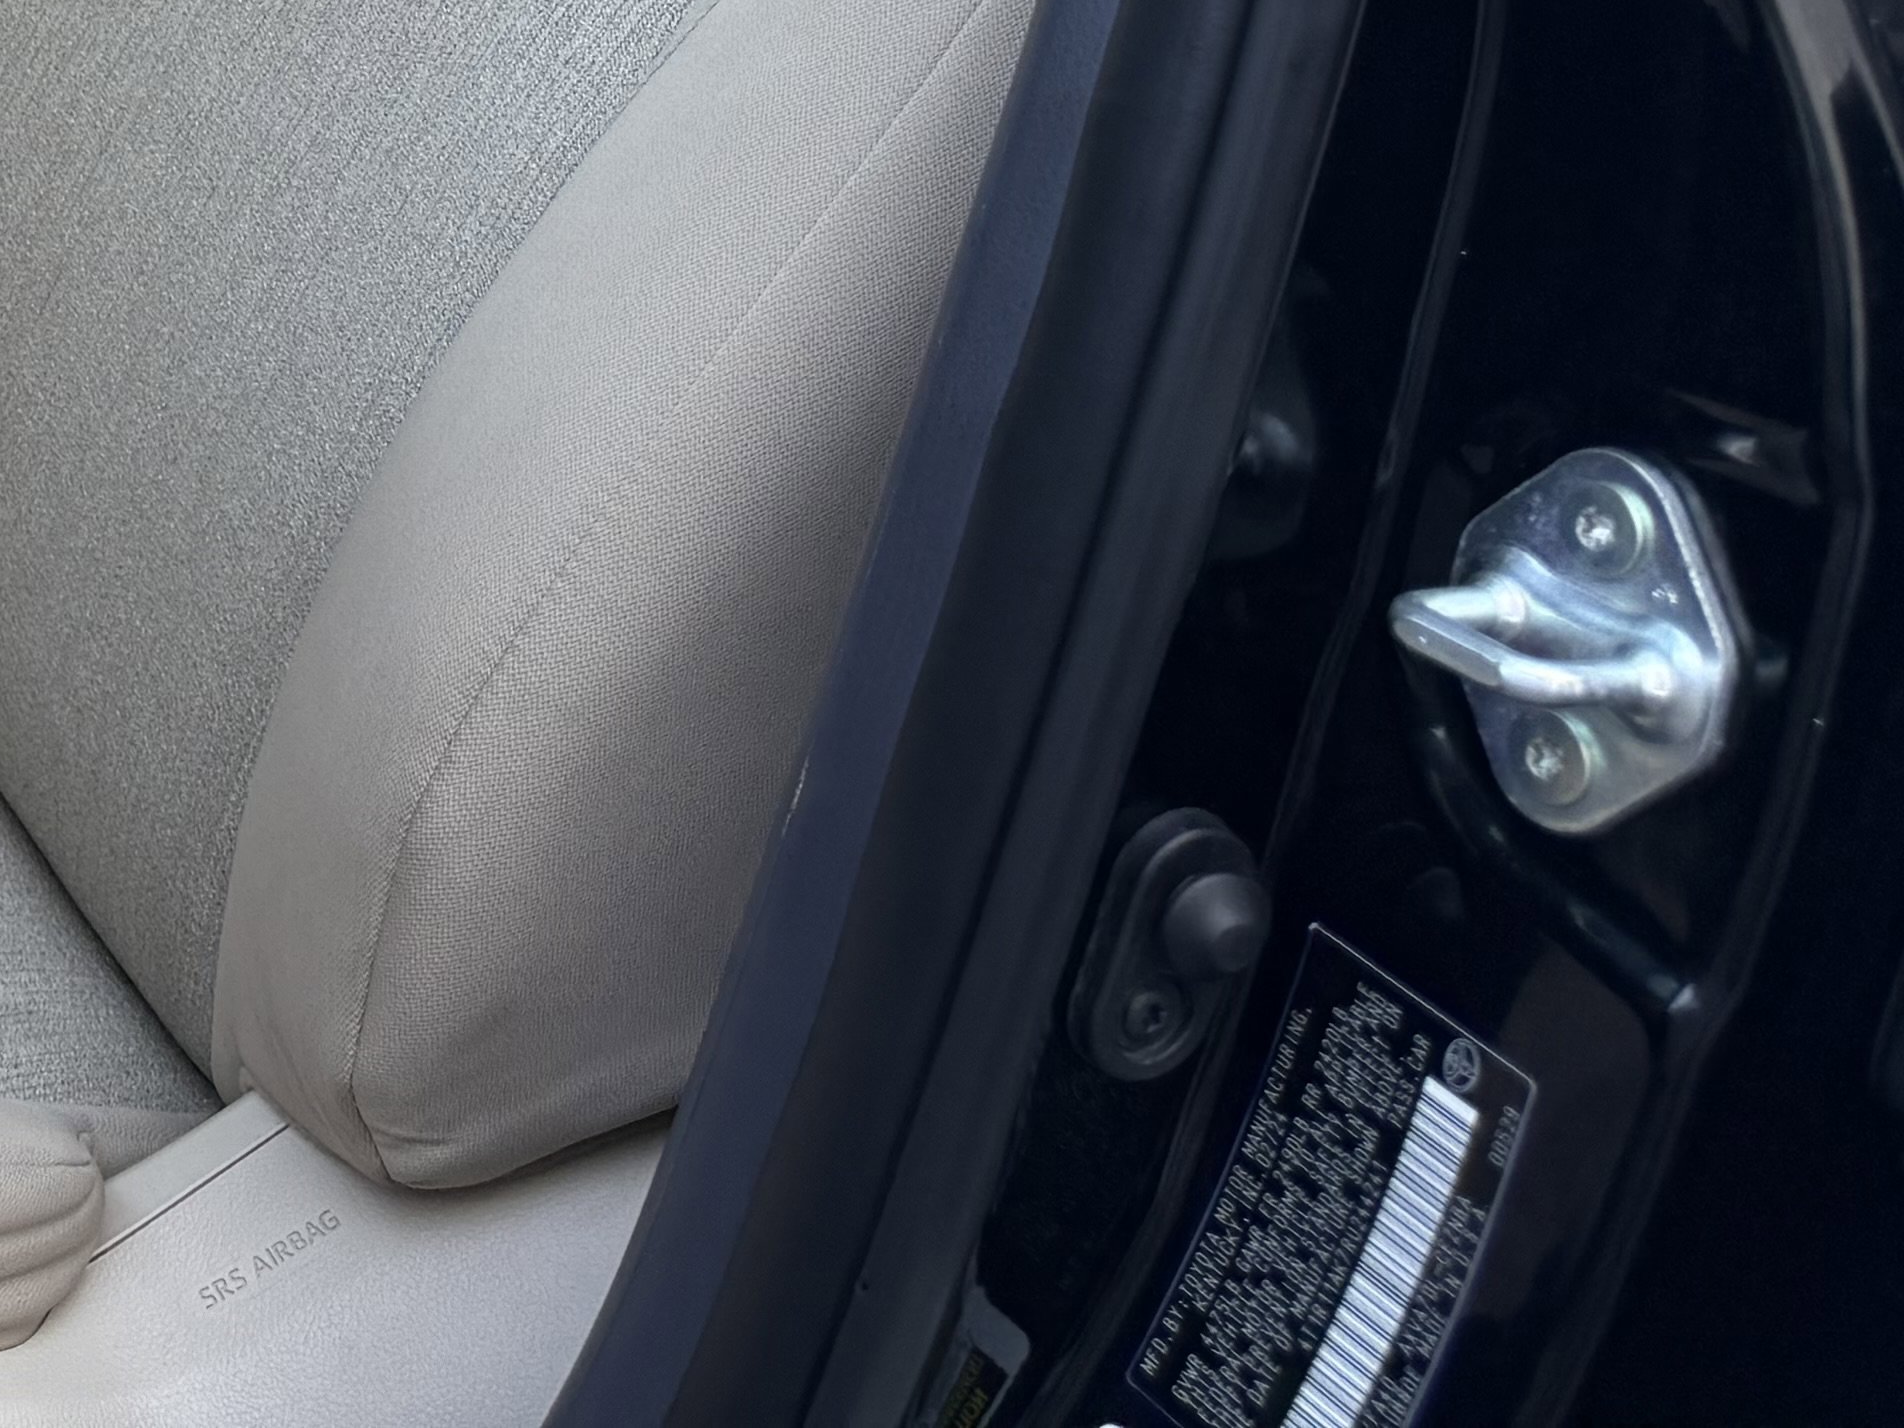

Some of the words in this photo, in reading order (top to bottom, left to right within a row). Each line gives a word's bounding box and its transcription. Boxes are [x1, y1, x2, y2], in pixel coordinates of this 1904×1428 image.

[1213, 1163, 1248, 1224] MOTOR
[1239, 1276, 1277, 1341] MOTOR
[1363, 989, 1386, 1032] AND
[198, 1265, 248, 1310] SRS
[252, 1208, 343, 1278] AIRBAG
[1170, 1350, 1204, 1403] GVWR
[1234, 1222, 1265, 1274] GAWR
[1184, 1363, 1216, 1410] THIS
[1211, 1276, 1259, 1358] VEHICLE
